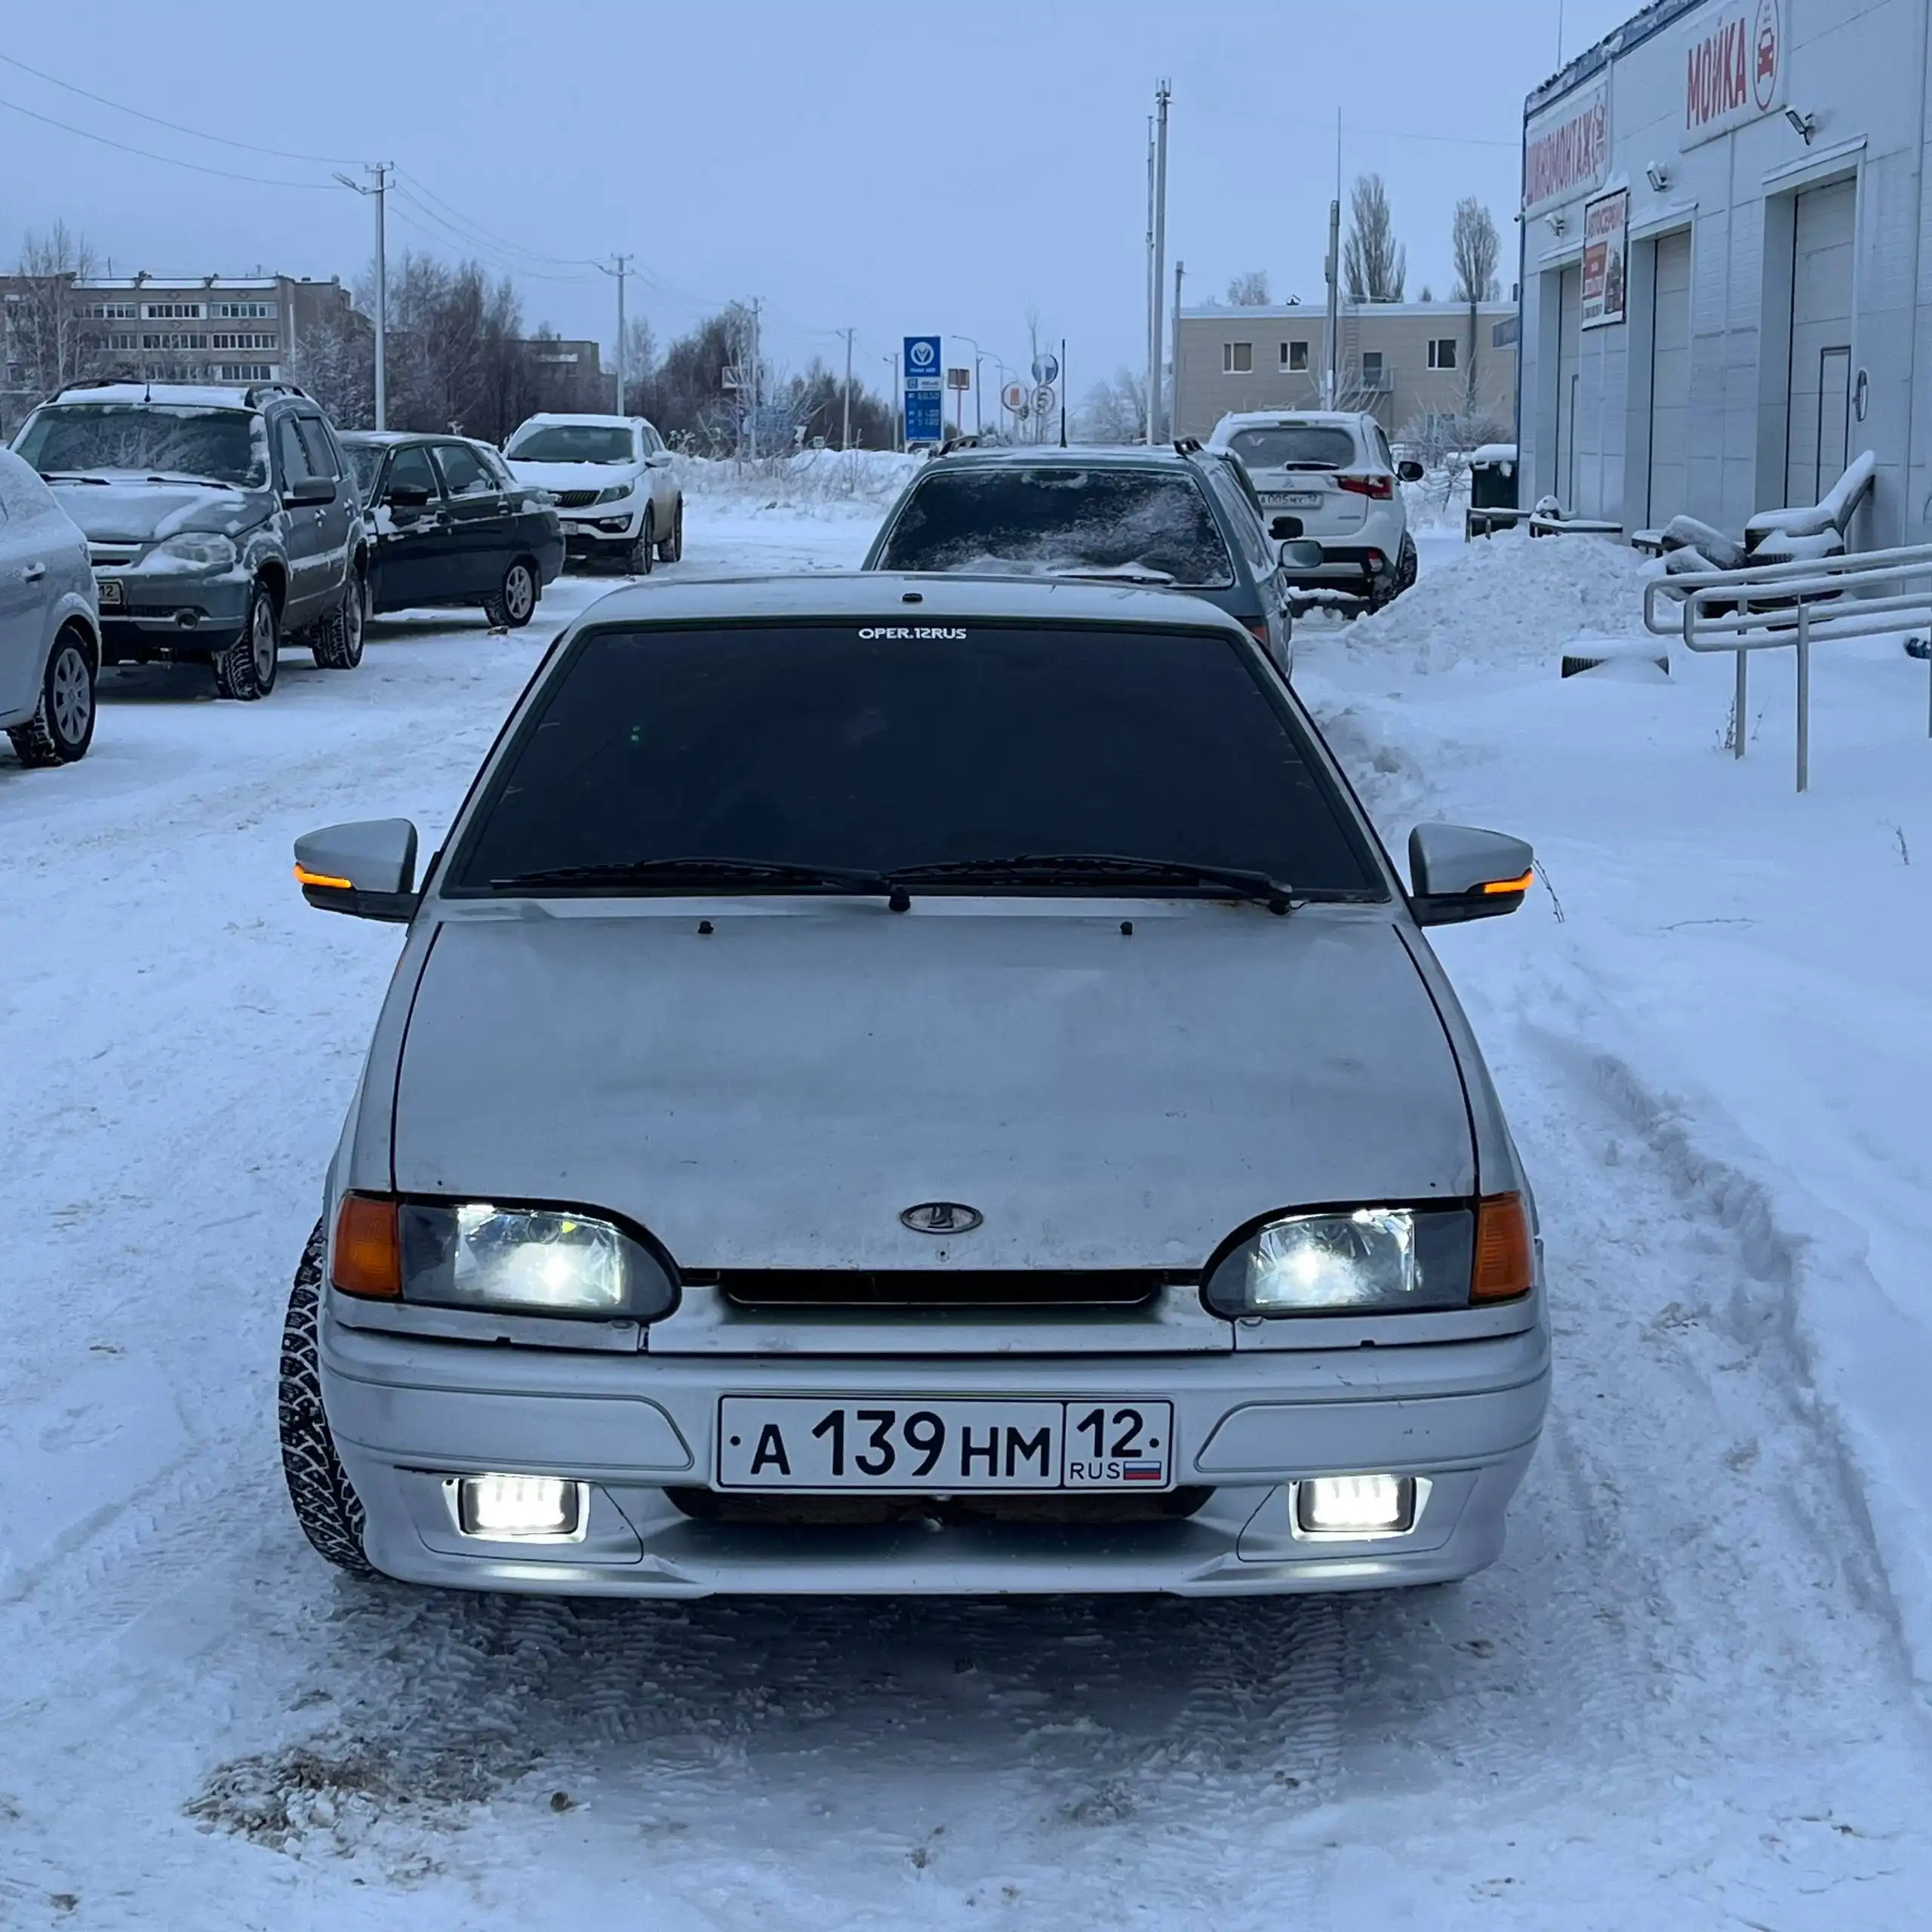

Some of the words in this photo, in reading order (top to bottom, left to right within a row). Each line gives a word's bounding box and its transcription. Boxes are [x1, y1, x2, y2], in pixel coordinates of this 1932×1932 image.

[1686, 16, 1747, 131] МОЙКА
[99, 585, 114, 597] 12
[858, 628, 967, 639] OPER.12RUS
[1076, 1407, 1144, 1459] 12
[1069, 1462, 1121, 1480] RUS
